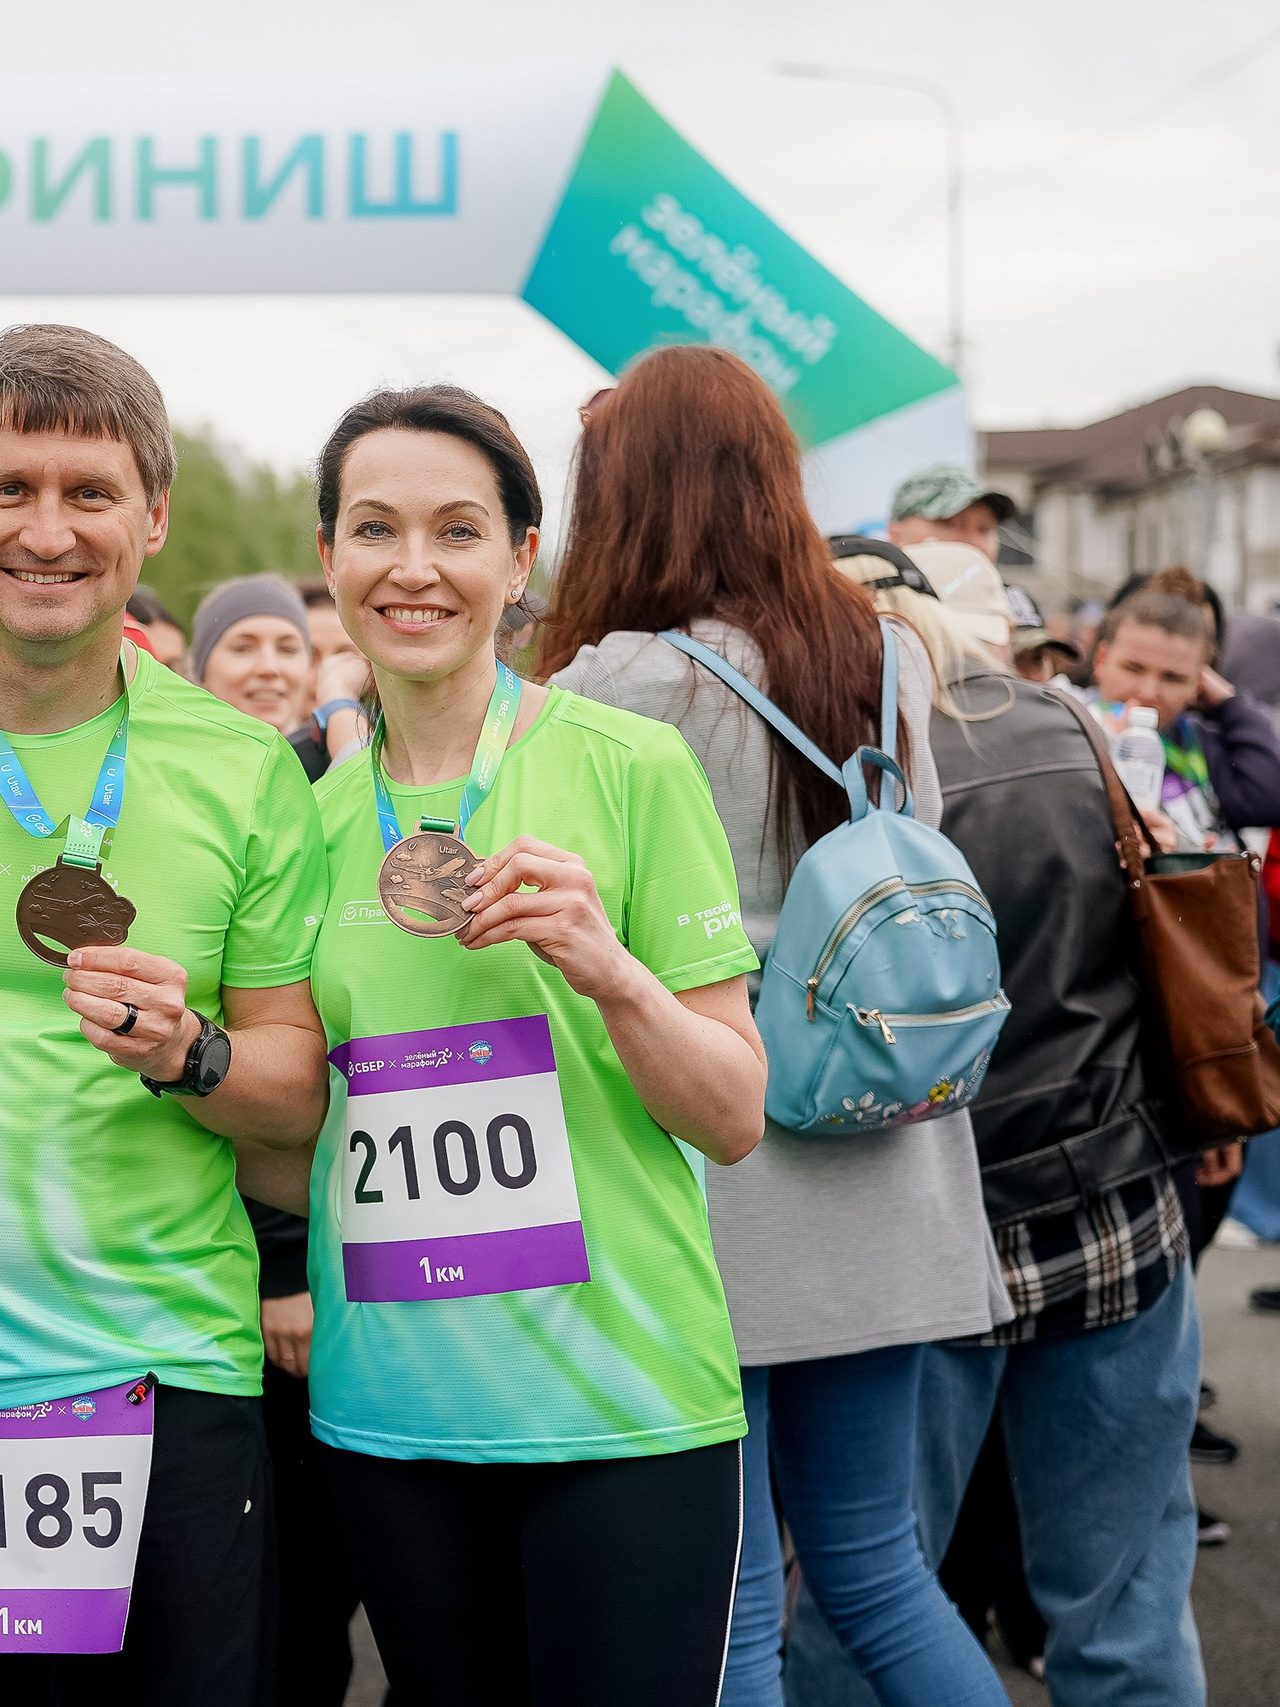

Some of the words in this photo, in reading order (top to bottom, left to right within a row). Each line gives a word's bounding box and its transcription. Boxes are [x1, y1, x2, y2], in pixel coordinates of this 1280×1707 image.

[640, 193, 837, 364] зелёный
[498, 699, 510, 718] 185
[6, 775, 23, 798] Utair
[102, 783, 115, 806] Utair
[439, 846, 459, 855] Utair
[677, 914, 691, 926] В
[404, 1050, 437, 1062] зелёный
[354, 1061, 385, 1074] СБЕР
[401, 1060, 435, 1070] марафон
[349, 1113, 538, 1204] 2100
